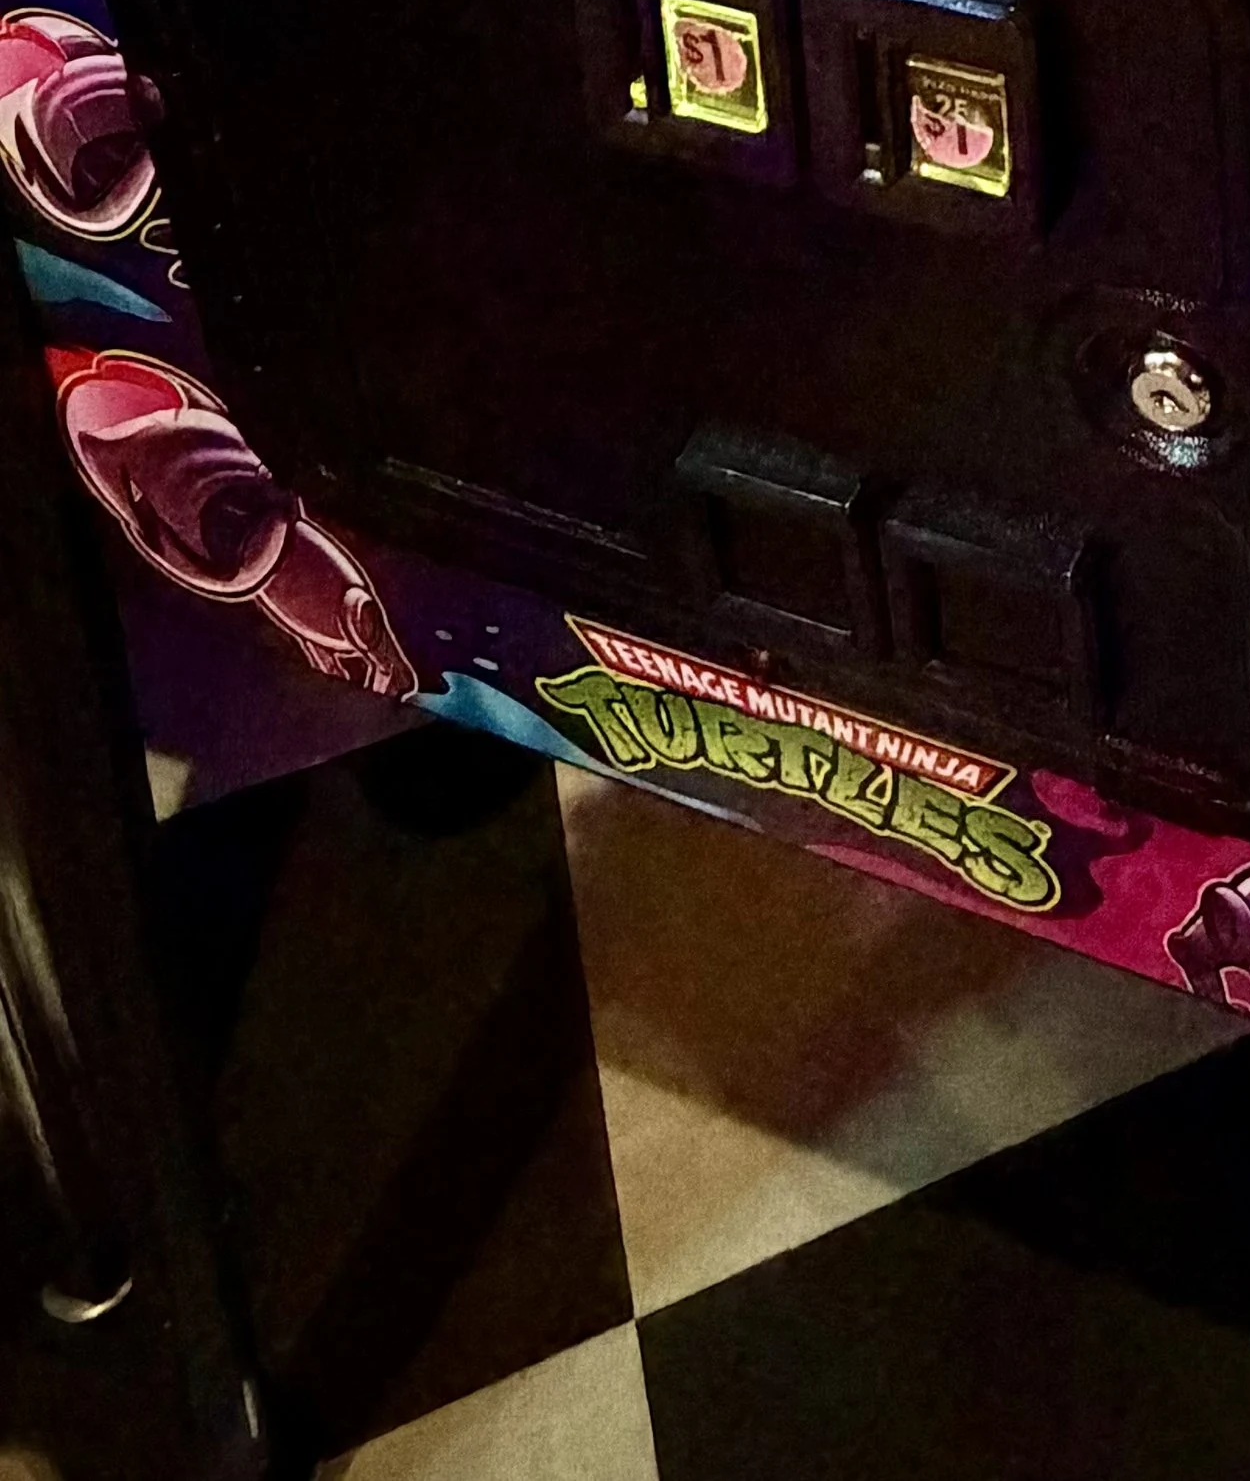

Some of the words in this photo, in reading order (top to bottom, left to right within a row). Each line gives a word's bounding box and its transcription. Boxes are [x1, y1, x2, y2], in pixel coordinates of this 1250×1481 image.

[682, 28, 727, 83] $1
[546, 666, 1054, 906] TURTLES
[589, 631, 745, 709] TEENAGE
[744, 686, 877, 751] MUTANT
[877, 724, 984, 791] NINJA
